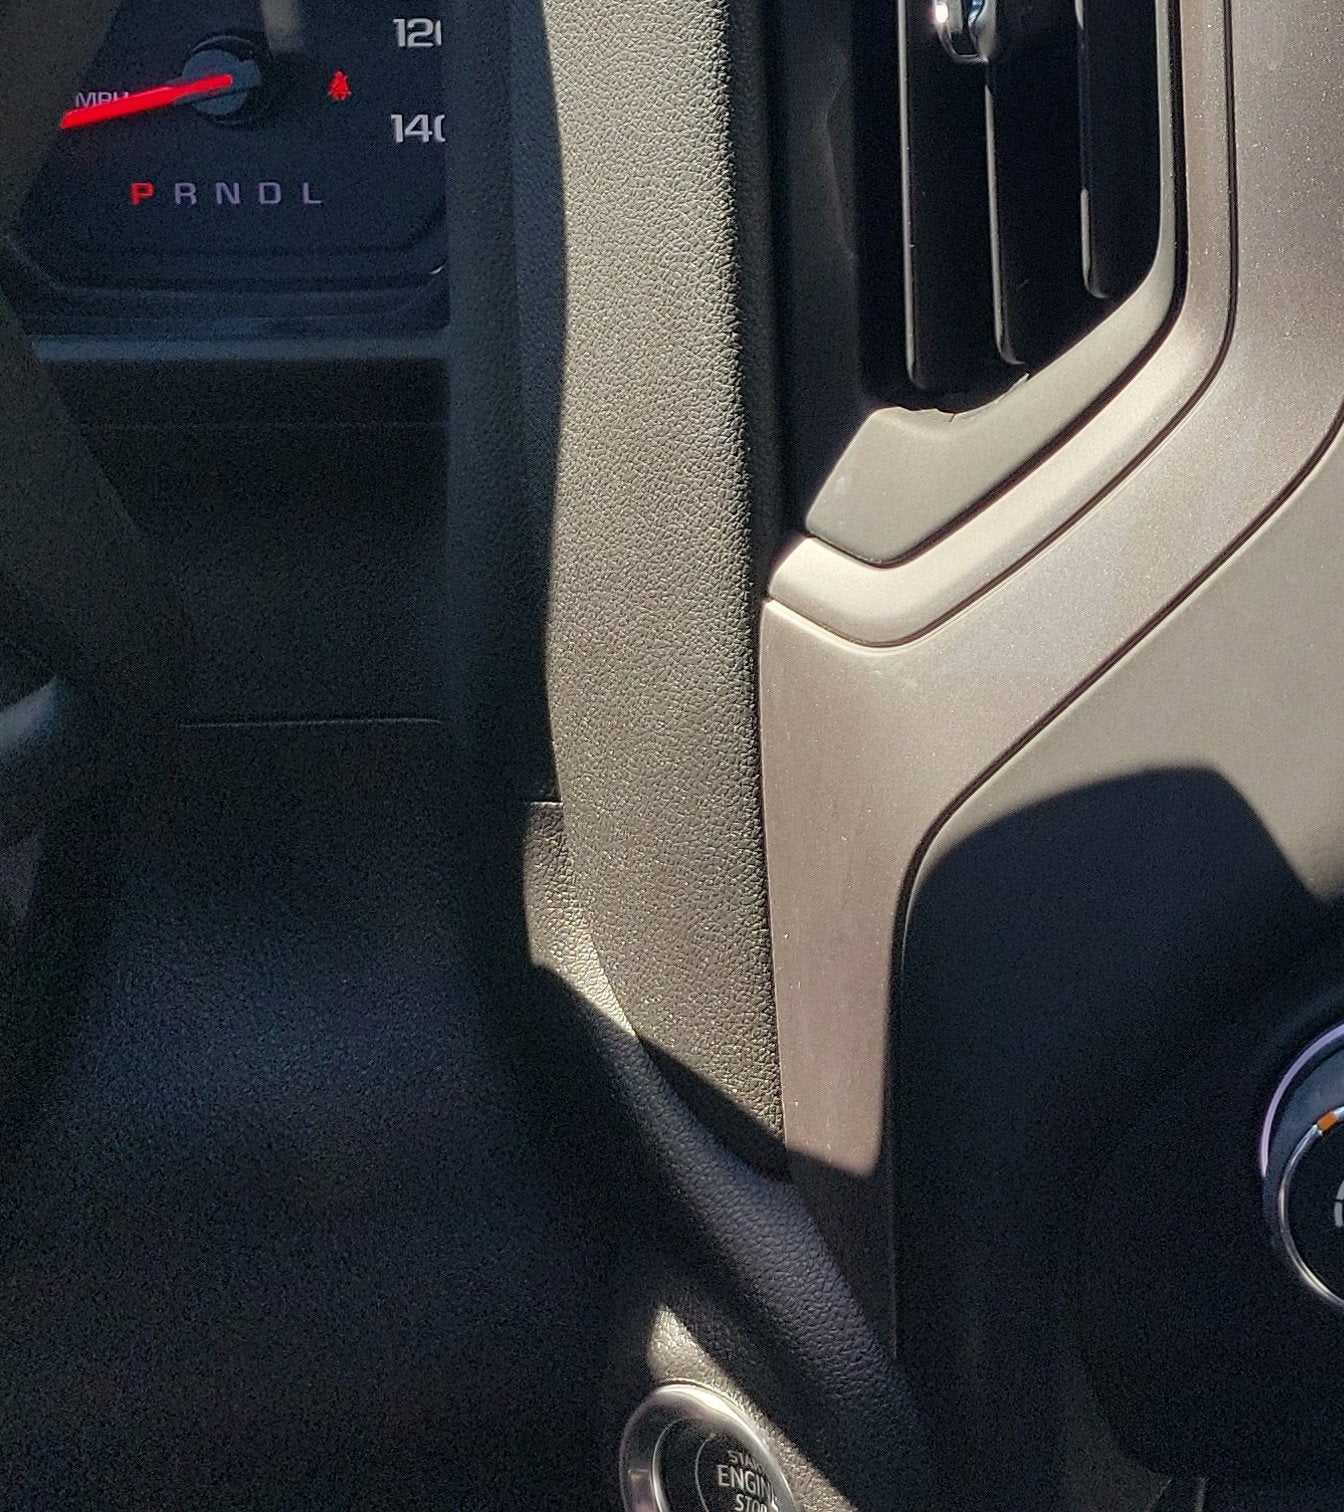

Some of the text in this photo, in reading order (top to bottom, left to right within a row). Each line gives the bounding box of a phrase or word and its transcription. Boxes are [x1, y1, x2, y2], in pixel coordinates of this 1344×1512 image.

[393, 17, 442, 47] 12
[131, 182, 323, 205] P R N D L
